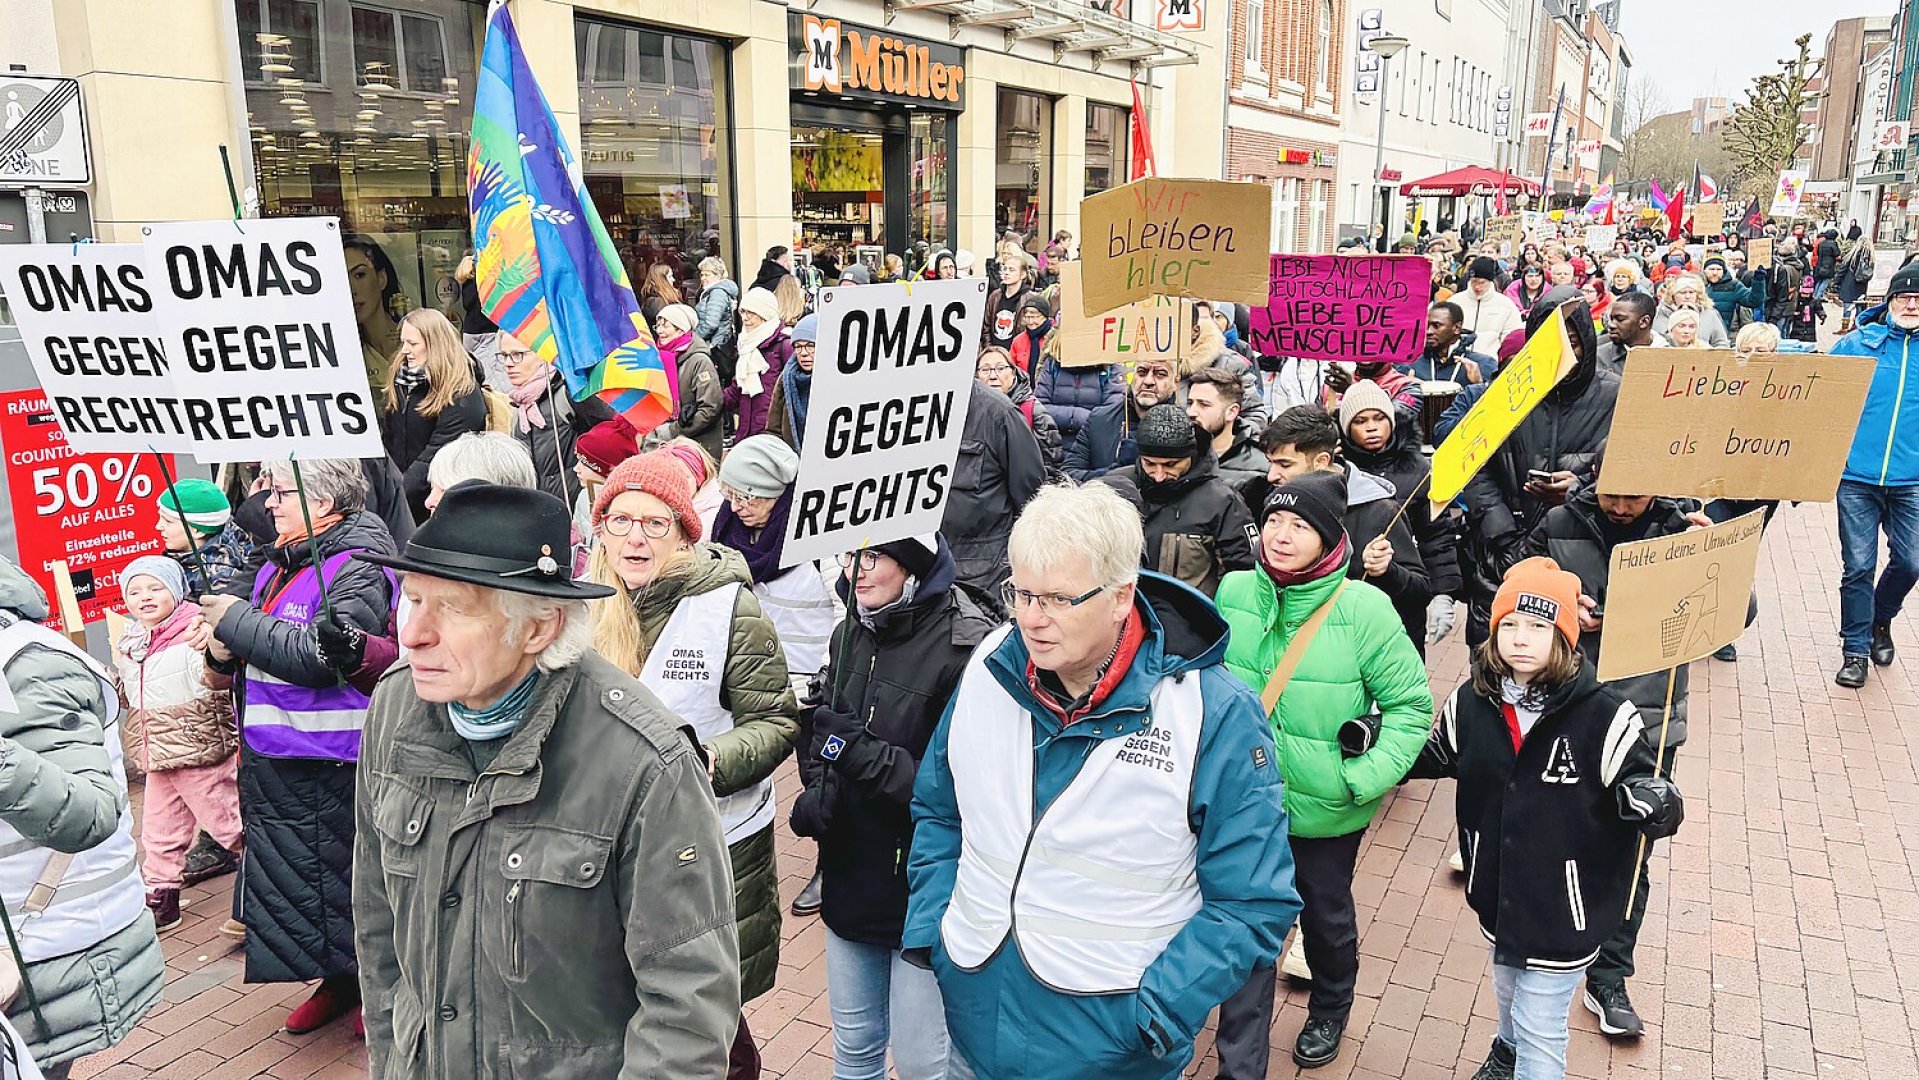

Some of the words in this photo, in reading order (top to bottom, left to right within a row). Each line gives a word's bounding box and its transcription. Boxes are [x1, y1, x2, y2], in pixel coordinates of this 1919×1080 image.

[814, 38, 832, 70] M
[848, 31, 964, 102] Müller
[4, 160, 61, 175] ZNE
[1133, 183, 1201, 213] Wir
[165, 241, 322, 300] OMAS
[1127, 253, 1210, 290] hier
[1327, 257, 1407, 281] NICHT
[18, 264, 153, 313] OMAS
[183, 322, 340, 374] GEGEN
[837, 301, 966, 375] OMAS
[1102, 316, 1173, 352] FLAU
[44, 336, 170, 377] GEGEN
[1663, 364, 1750, 398] Lieber
[1761, 367, 1822, 400] bunt
[54, 396, 185, 435] RECHT
[183, 392, 368, 441] RECHTS
[824, 391, 954, 459] GEGEN
[12, 445, 87, 466] COUNTD
[1669, 433, 1699, 455] als
[1725, 427, 1791, 457] braun
[60, 512, 90, 529] AUF
[94, 504, 135, 523] ALLES
[793, 463, 949, 541] RECHTS
[65, 530, 135, 552] Einzelteile
[67, 552, 97, 568] 72%
[99, 538, 159, 561] reduziert
[1619, 547, 1655, 570] Halte
[1665, 541, 1696, 560] deine
[1703, 525, 1739, 552] Umwelt
[1520, 594, 1556, 614] BLACK
[665, 660, 705, 670] GEGEN
[672, 648, 704, 659] OMAS
[662, 670, 710, 680] RECHTS
[1115, 749, 1175, 773] RECHTS
[1124, 736, 1171, 757] GEGEN
